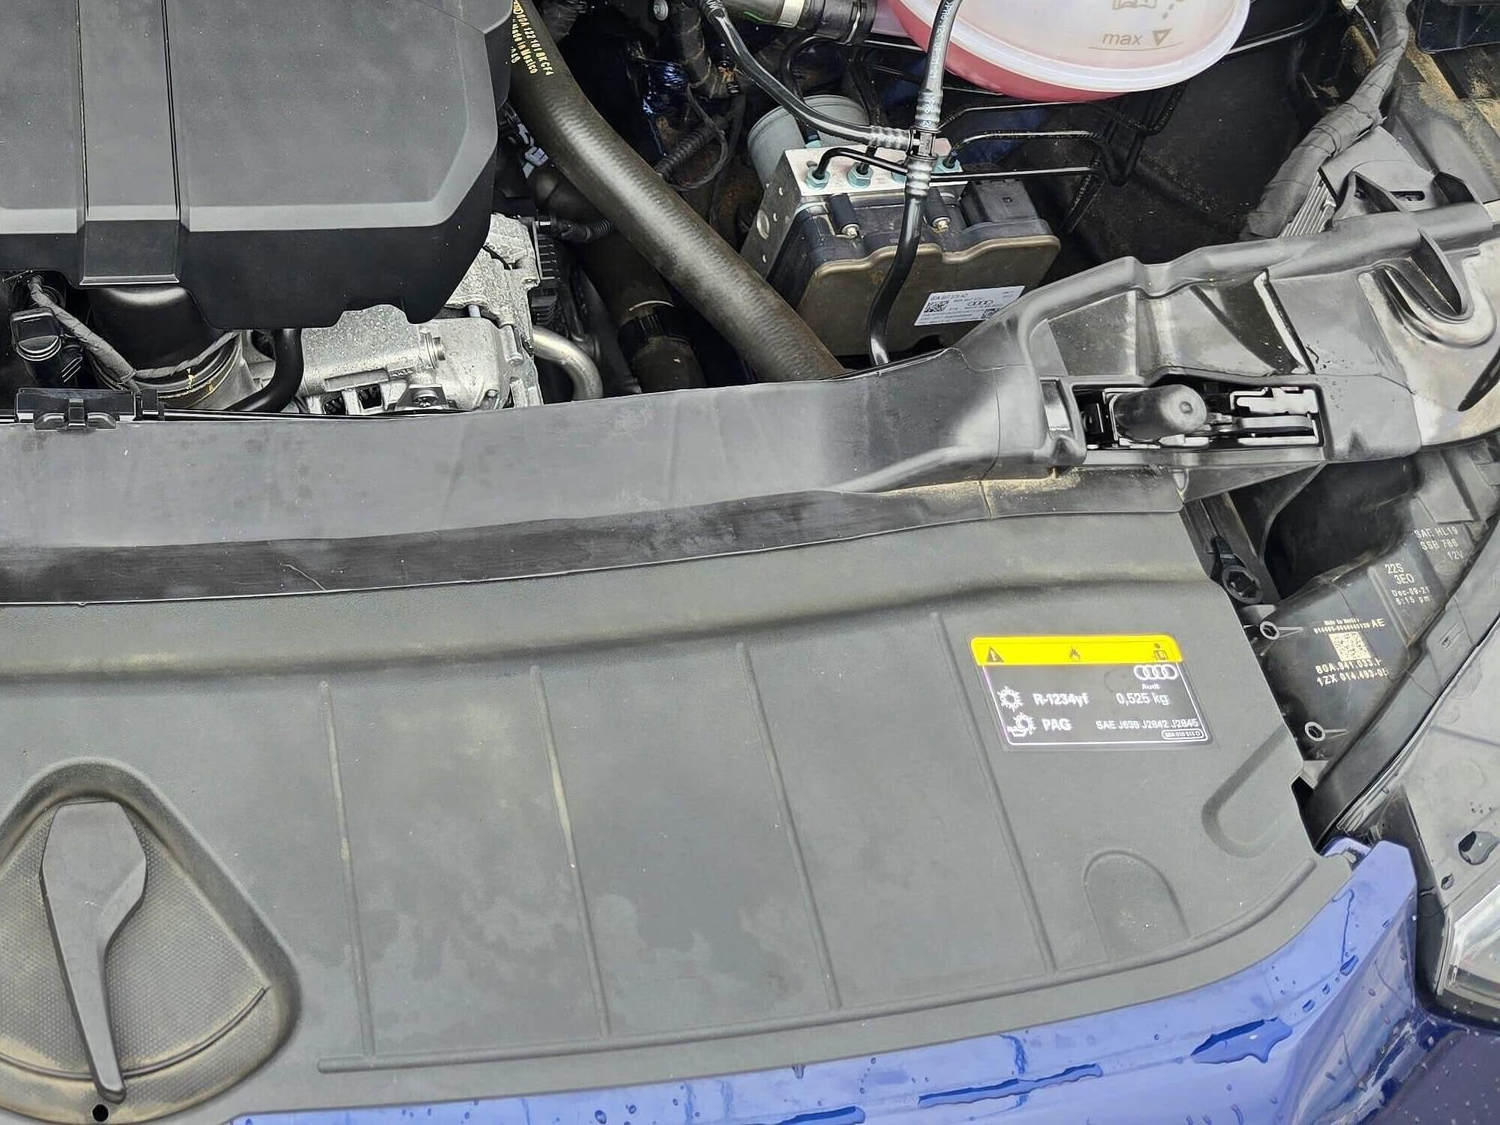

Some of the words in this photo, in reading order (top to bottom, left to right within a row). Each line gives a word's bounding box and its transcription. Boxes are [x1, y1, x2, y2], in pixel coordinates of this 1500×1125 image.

[1101, 31, 1143, 47] max
[1385, 563, 1404, 574] 22S
[1371, 618, 1385, 627] AE
[1142, 682, 1161, 690] Audi
[1317, 675, 1338, 687] 1ZX
[1033, 692, 1090, 707] R-1234yf
[1115, 692, 1149, 705] 0,525
[1152, 692, 1170, 706] kg
[1042, 718, 1072, 731] PAG
[1095, 720, 1116, 730] SAE
